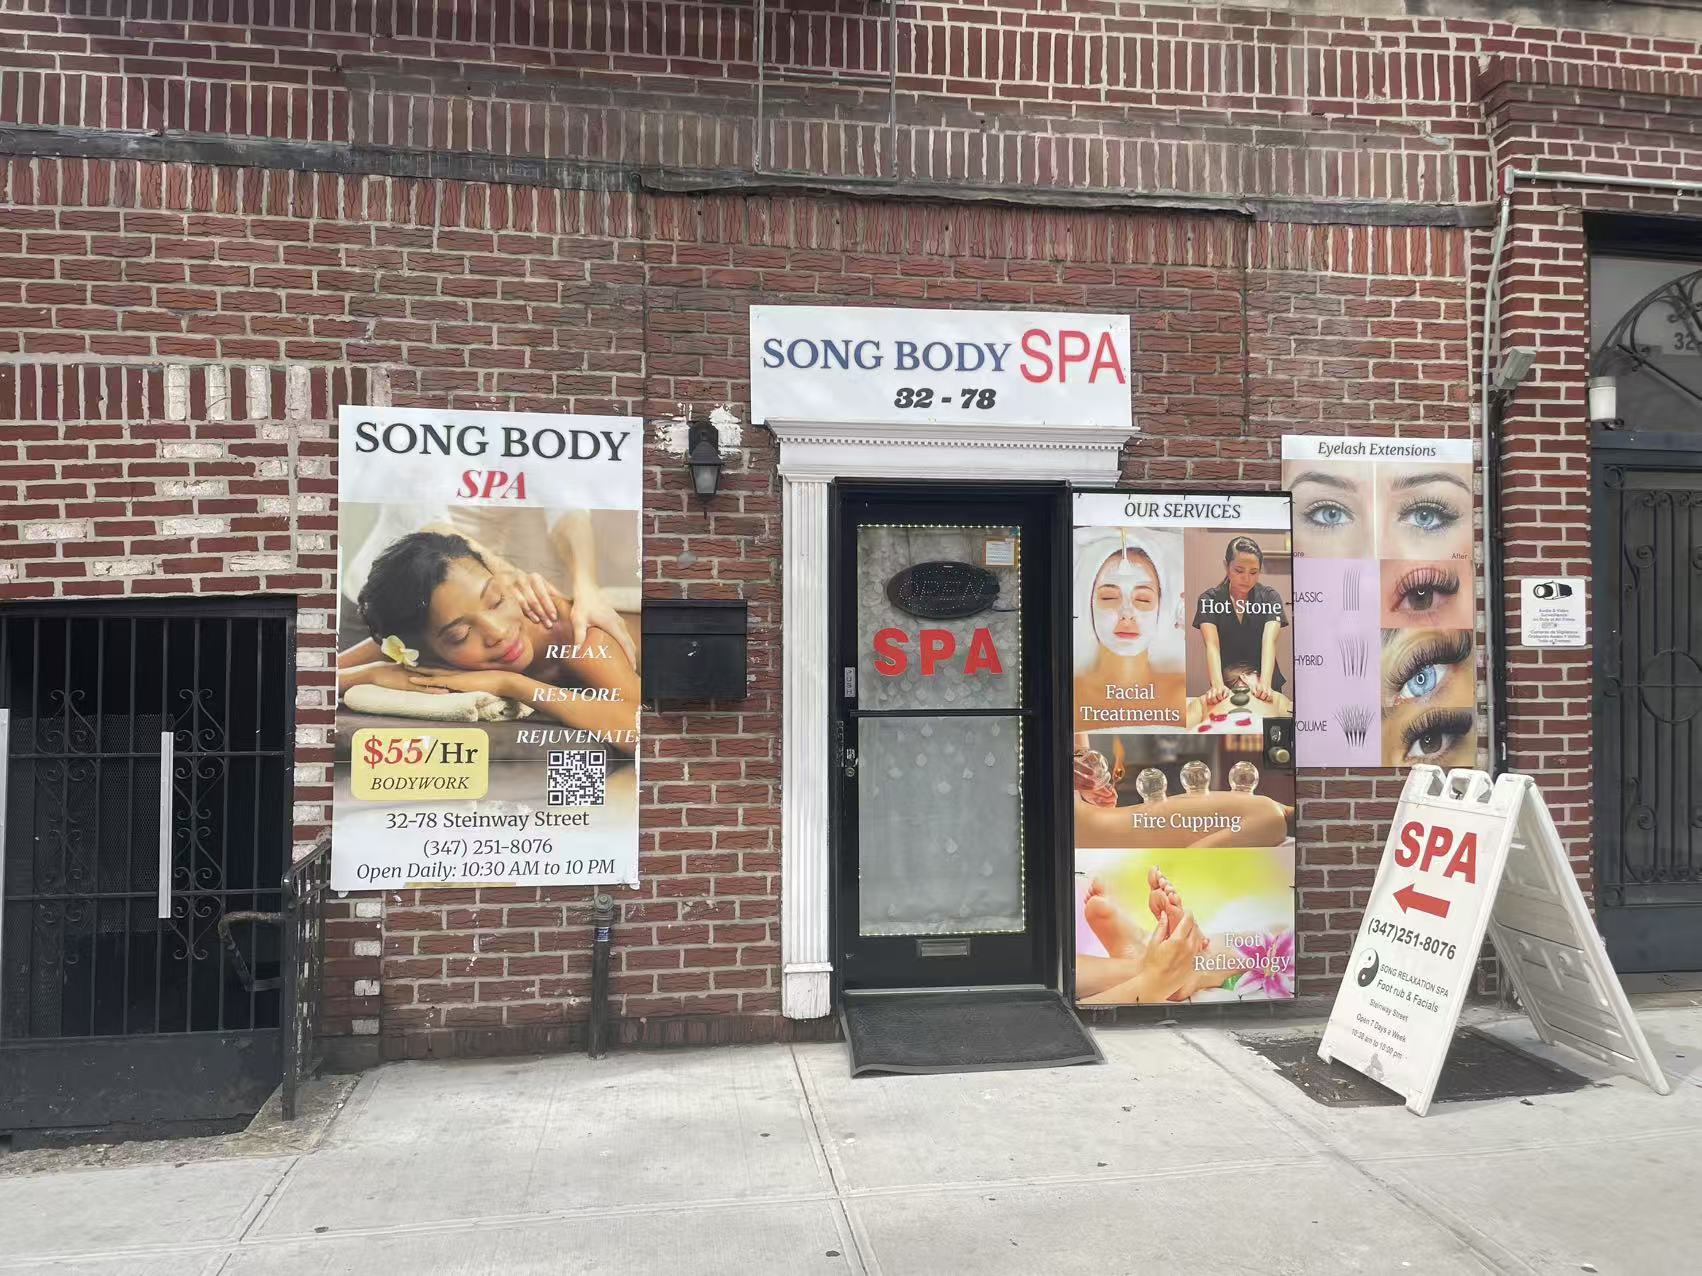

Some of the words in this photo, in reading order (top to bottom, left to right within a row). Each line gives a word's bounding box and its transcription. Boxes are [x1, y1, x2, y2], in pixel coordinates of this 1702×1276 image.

[763, 338, 883, 370] SONG
[894, 341, 1011, 372] BODY
[1019, 328, 1125, 384] SPA
[894, 387, 933, 409] 32
[961, 388, 996, 410] 78
[355, 421, 488, 457] SONG
[501, 427, 630, 461] BODY
[1318, 441, 1365, 458] Eyelash
[1370, 443, 1436, 457] Extensions
[456, 470, 526, 499] SPA
[1124, 502, 1159, 517] OUR
[1163, 503, 1241, 519] SERVICES
[1451, 552, 1467, 560] After
[1200, 599, 1231, 615] Hot
[1235, 599, 1281, 615] Stone
[545, 644, 613, 659] RELAX.
[873, 627, 1003, 677] SPA
[532, 687, 624, 702] RESTORE.
[1105, 684, 1155, 700] Facial
[1080, 706, 1180, 722] Treatments
[363, 735, 479, 769] $55/Hr
[370, 776, 469, 790] BODYWORK
[385, 813, 438, 829] 32-78
[443, 813, 530, 831] Steinway
[534, 811, 590, 827] Street
[1132, 813, 1166, 828] Fire
[1170, 813, 1242, 832] Cupping
[423, 840, 468, 857] (347)
[473, 838, 553, 855] 251-8076
[1394, 821, 1478, 885] SPA
[356, 863, 402, 883] Open
[406, 863, 457, 881] Daily:
[460, 861, 505, 877] 10:30
[510, 860, 540, 875] AM
[544, 860, 560, 874] to
[566, 859, 584, 874] 10
[588, 859, 616, 874] PM
[1224, 933, 1261, 948] Foot
[1367, 918, 1457, 960] (347)251-8076
[1194, 955, 1290, 971] Reflexology
[1380, 964, 1397, 977] SONG
[1397, 971, 1436, 993] RELAXATION
[1435, 986, 1449, 998] SPA
[1376, 979, 1393, 993] Foot
[1394, 986, 1405, 998] rub
[1405, 991, 1411, 1001] &
[1412, 994, 1439, 1013] Facials
